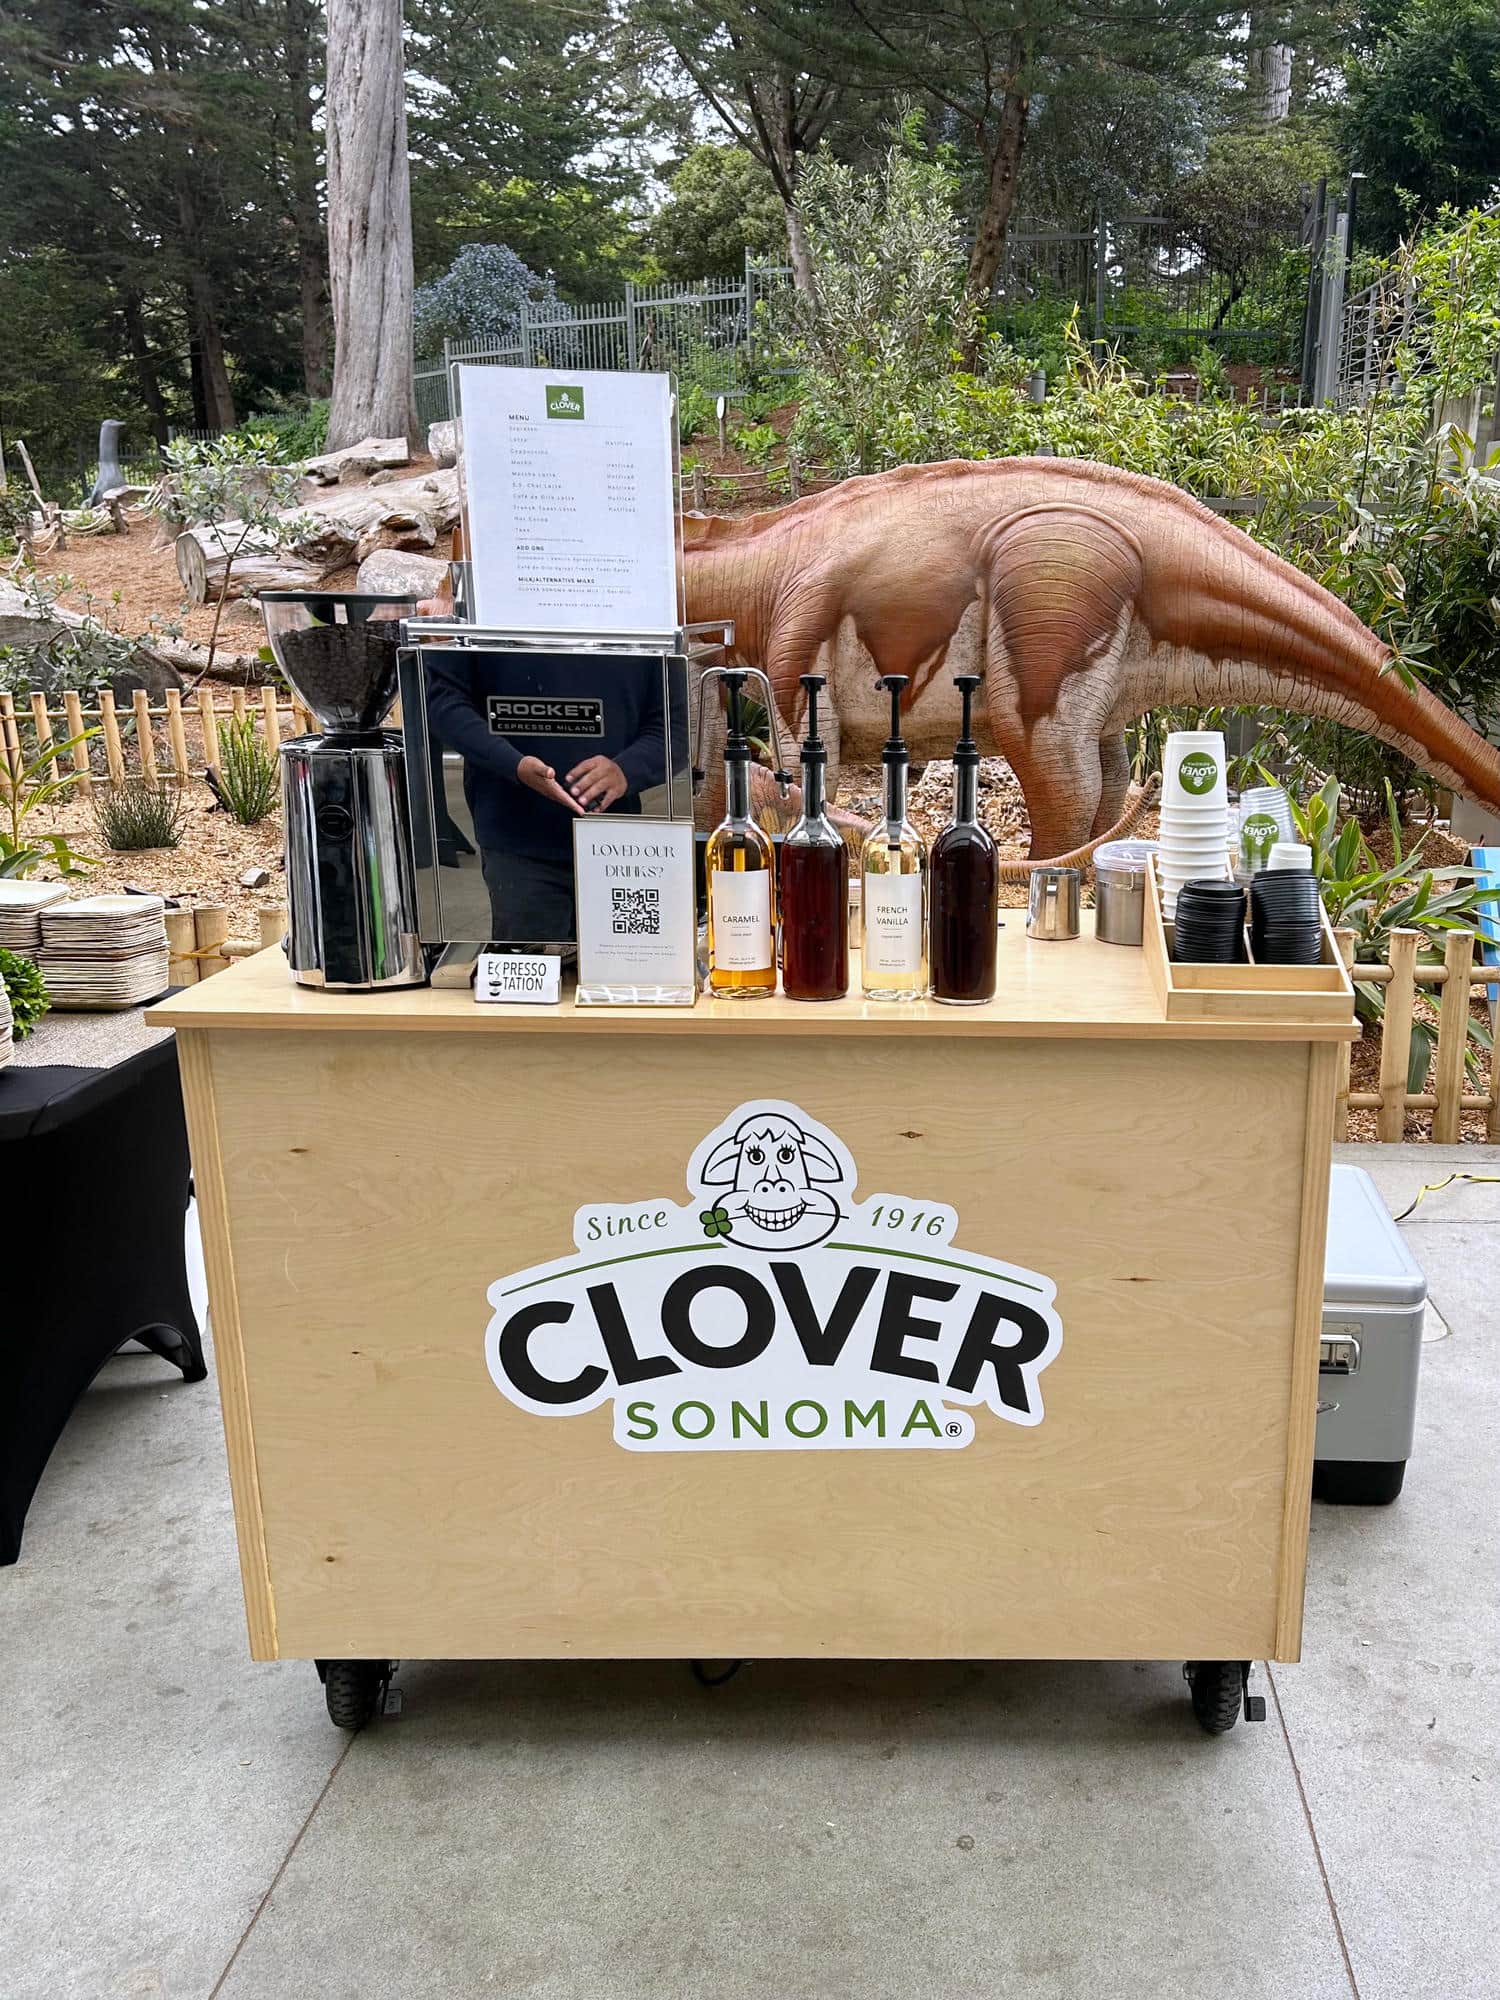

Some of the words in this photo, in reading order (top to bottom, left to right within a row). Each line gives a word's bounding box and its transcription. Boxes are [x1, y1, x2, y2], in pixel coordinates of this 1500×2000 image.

[550, 400, 581, 412] CLOVER
[496, 703, 594, 717] ROCKET
[497, 722, 552, 731] ESPRESSO
[1181, 763, 1217, 777] CLOVER
[1244, 824, 1278, 837] CLOVER
[592, 843, 640, 857] LOVED
[644, 845, 676, 858] OUR
[605, 865, 664, 879] DRINKS?
[876, 905, 908, 914] FRENCH
[722, 915, 760, 923] CARAMEL
[876, 917, 909, 925] VANILLA
[586, 1210, 669, 1242] Since
[870, 1205, 946, 1236] 1916
[499, 1261, 1051, 1414] CLOVER
